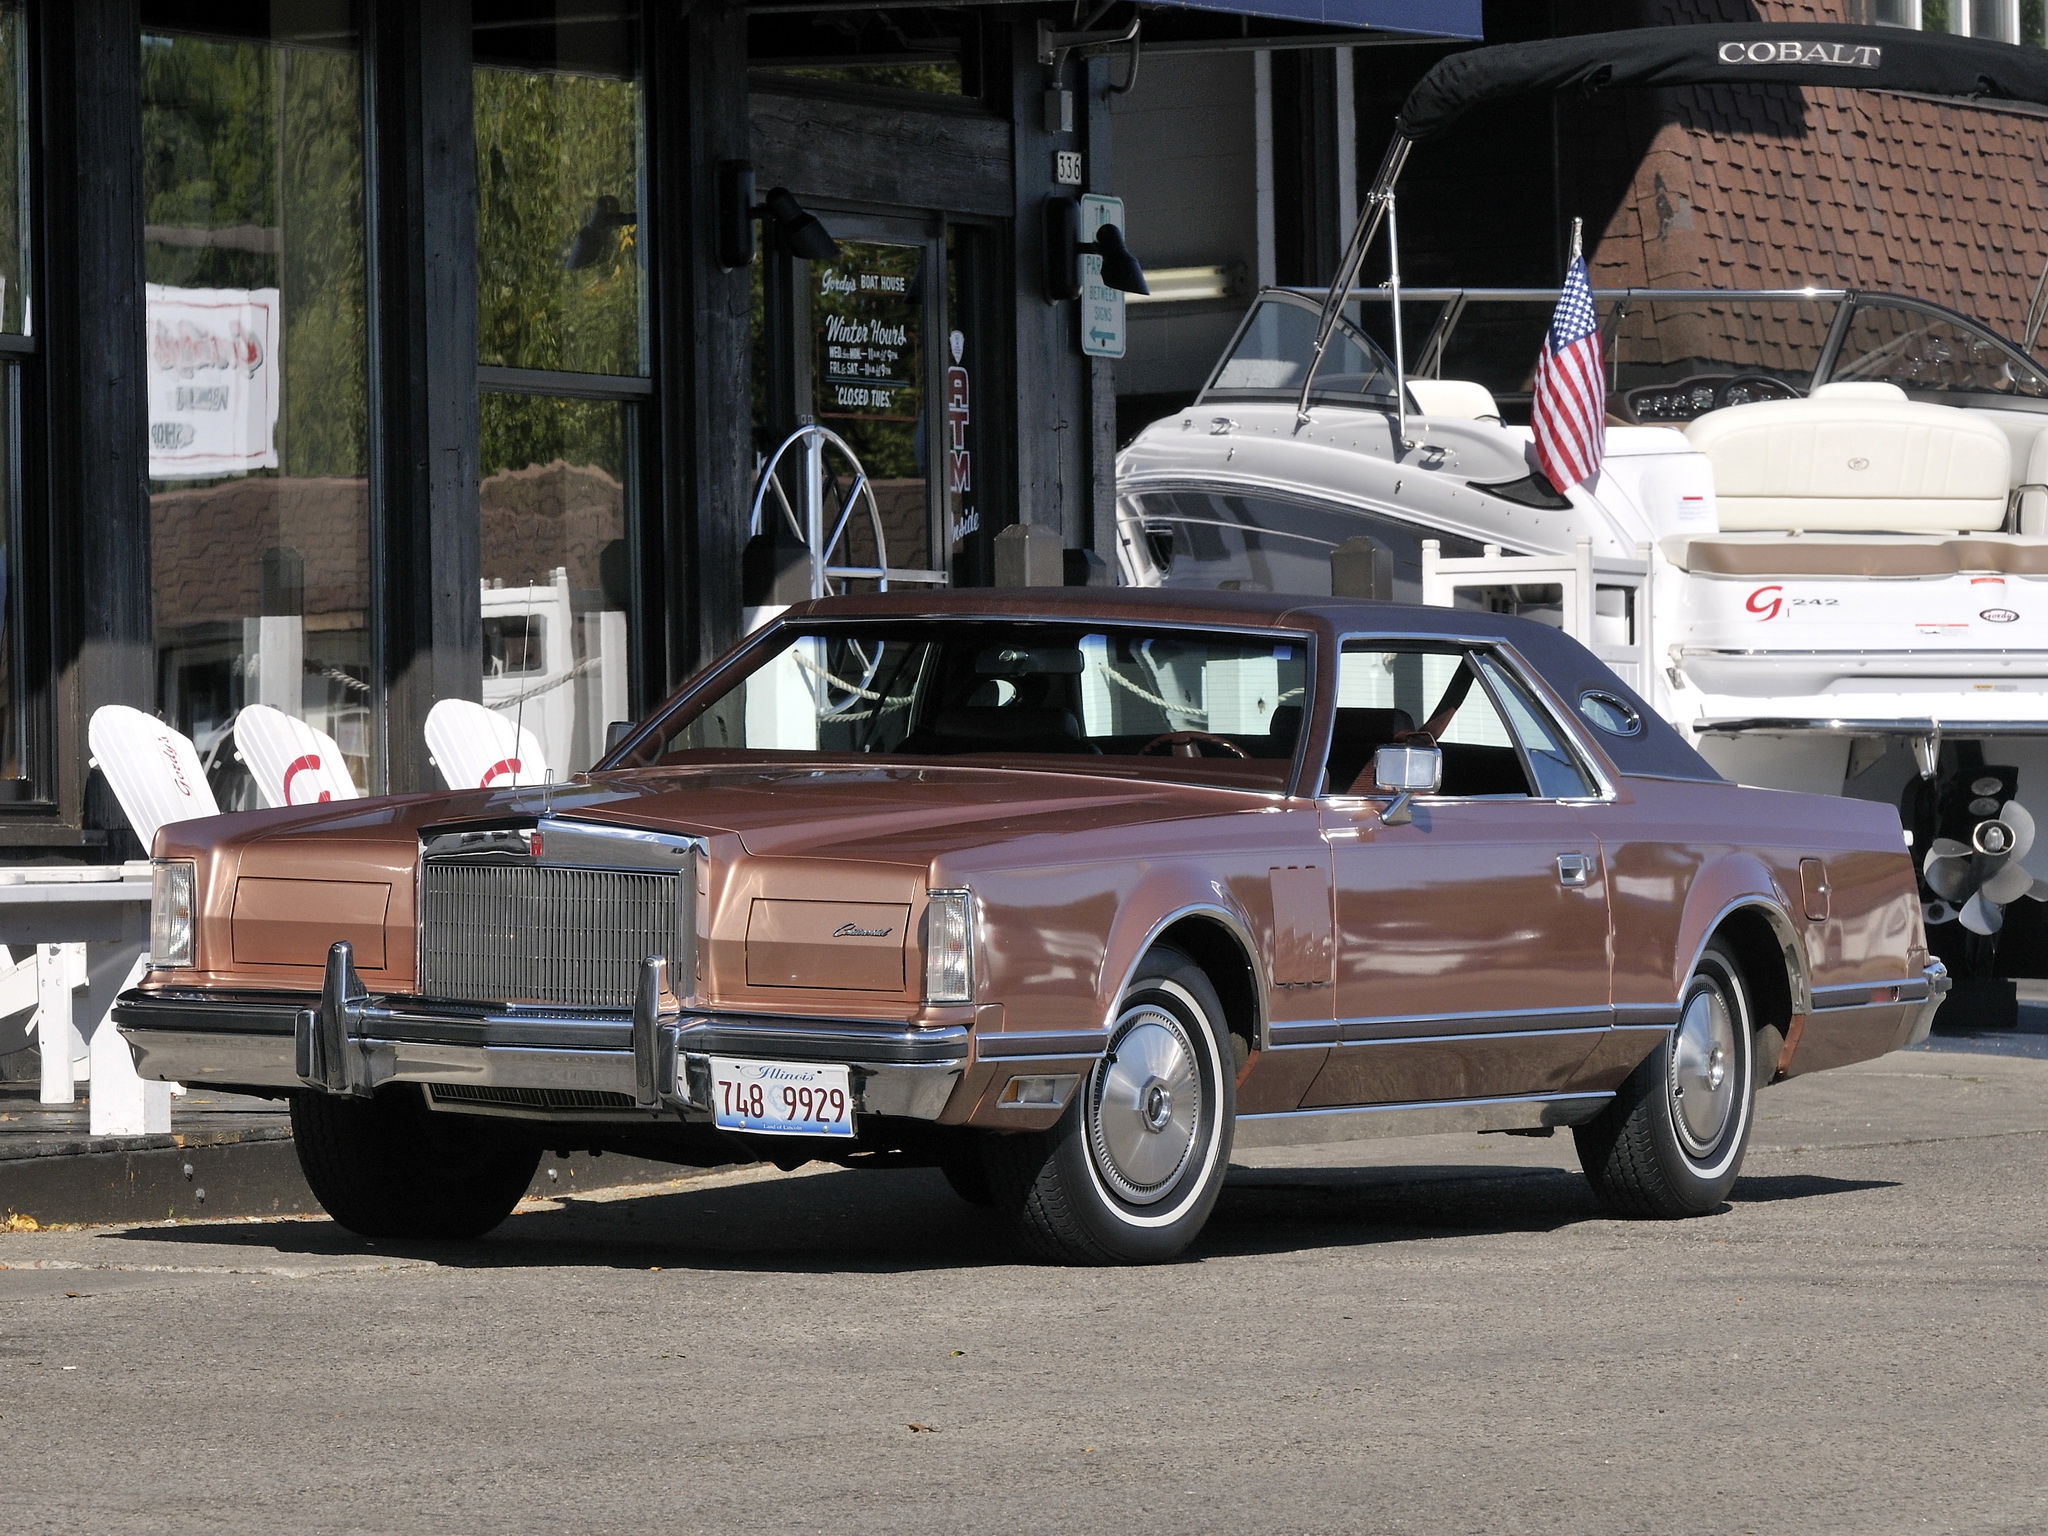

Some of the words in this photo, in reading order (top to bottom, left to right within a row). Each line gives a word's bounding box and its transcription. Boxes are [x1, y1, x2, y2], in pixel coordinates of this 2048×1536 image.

[1719, 42, 1881, 66] COBALT
[1059, 155, 1081, 180] 336
[860, 274, 879, 290] BOAT
[880, 275, 905, 292] HOUSE
[1094, 306, 1112, 322] SIGNS
[826, 314, 868, 343] Winter
[870, 318, 907, 346] Hours
[948, 366, 970, 492] ATM
[1792, 598, 1840, 606] 242
[748, 1065, 815, 1082] Illinois
[718, 1080, 765, 1119] 748
[782, 1086, 845, 1123] 9929
